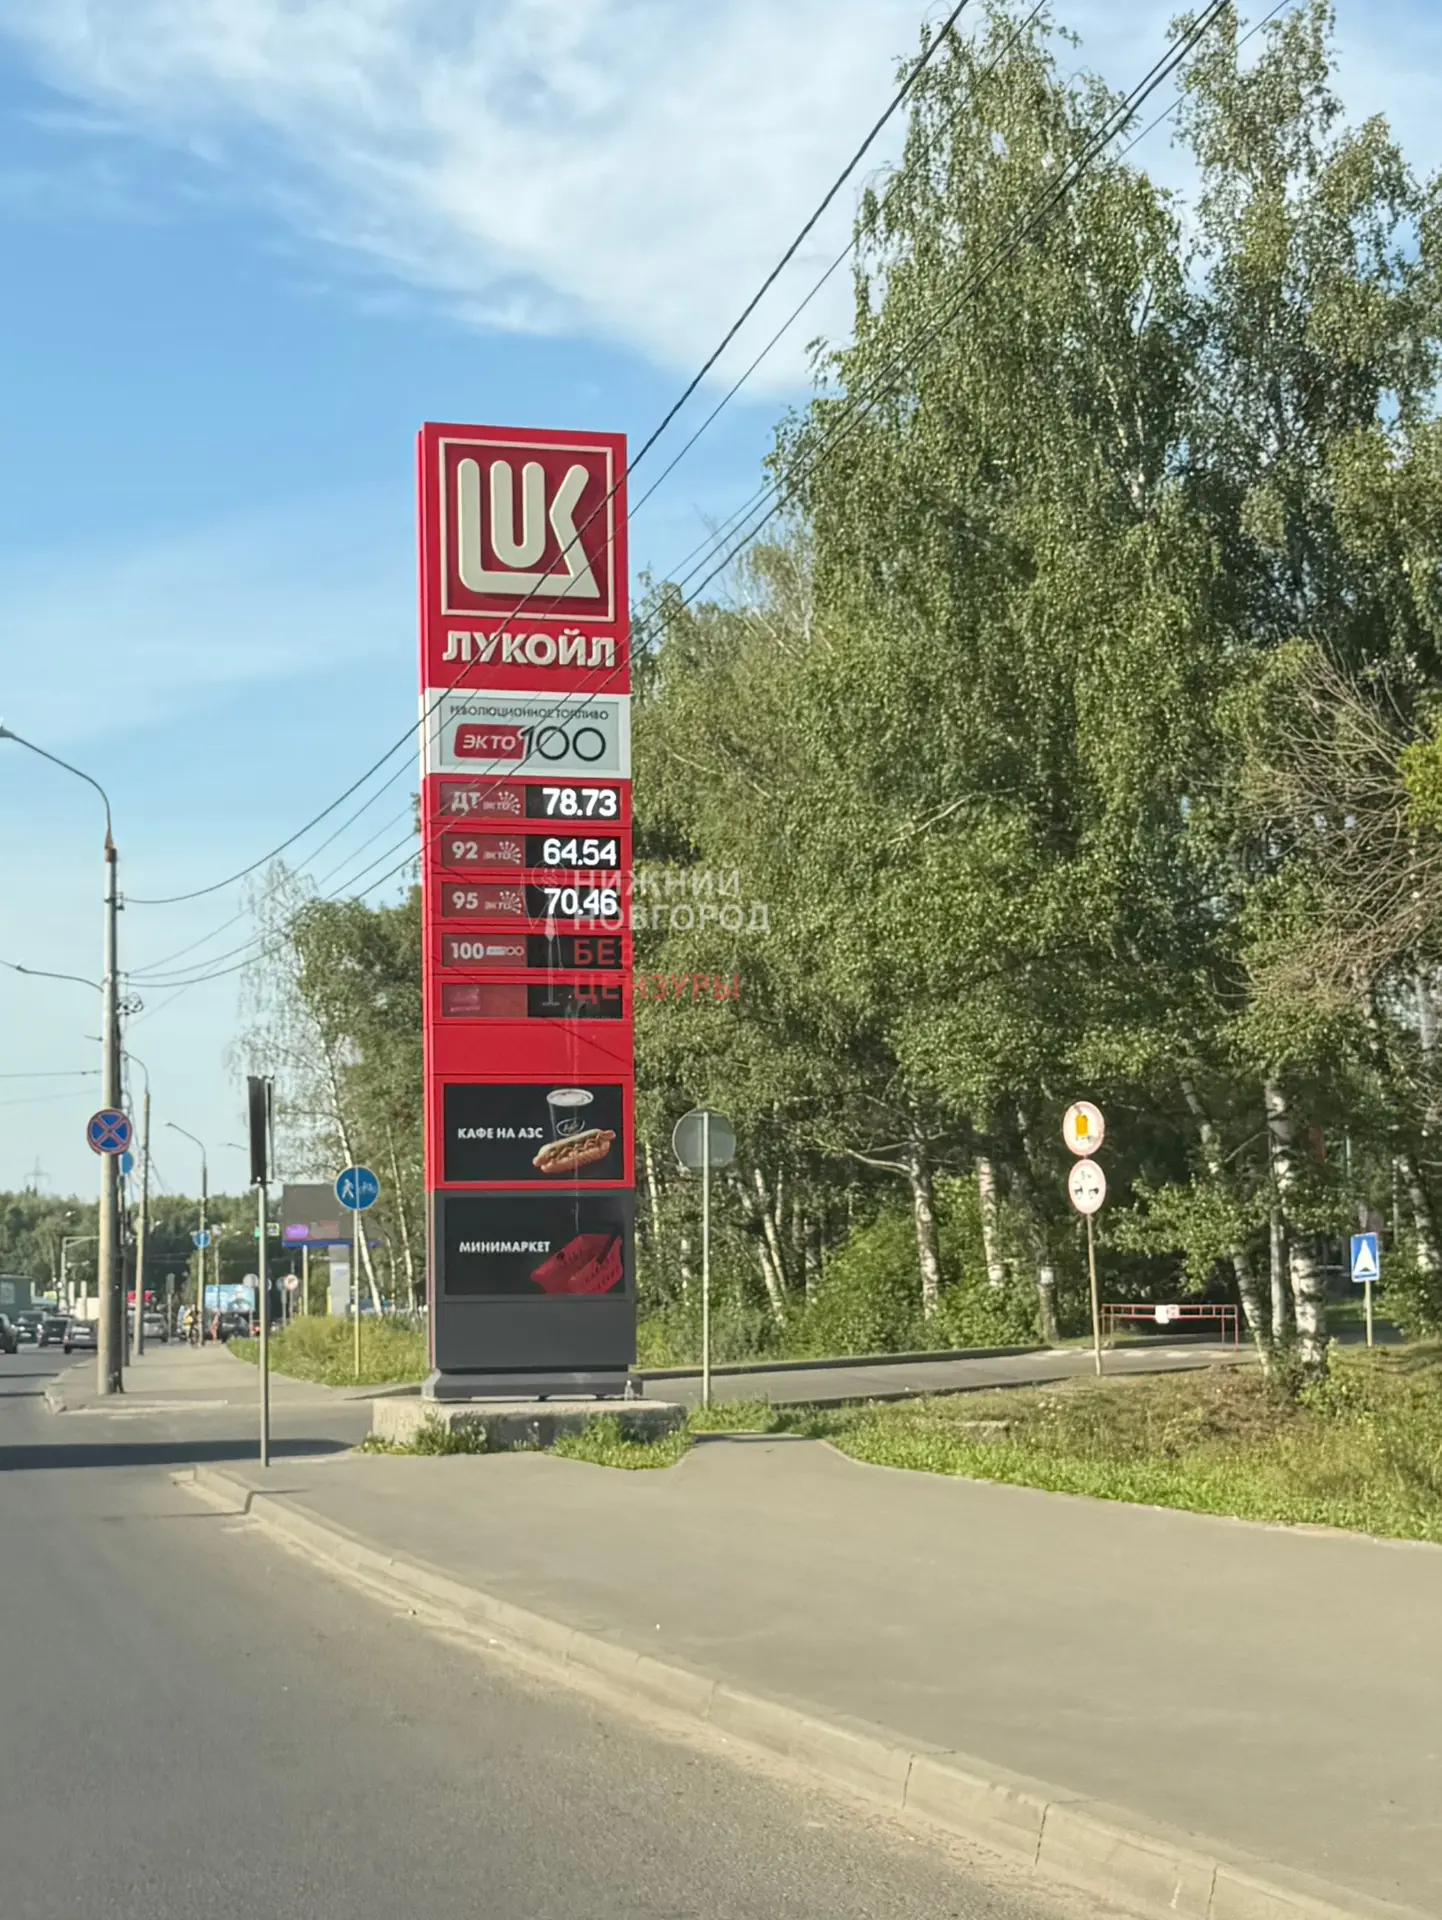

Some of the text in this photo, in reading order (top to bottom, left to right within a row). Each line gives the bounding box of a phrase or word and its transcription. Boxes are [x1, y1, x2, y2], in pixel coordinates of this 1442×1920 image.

[442, 628, 616, 668] ЛУКОЙЛ
[462, 725, 606, 762] ЭКТО 100
[451, 791, 481, 812] ДТ
[542, 787, 617, 817] 78.73
[451, 841, 479, 860] 92
[542, 838, 617, 866] 64.54
[452, 891, 479, 910] 95
[543, 887, 618, 916] 70.46
[451, 942, 485, 959] 100
[457, 1127, 544, 1140] КАФЕ НА АЗС
[458, 1240, 551, 1254] МИНИМАРКЕТ
